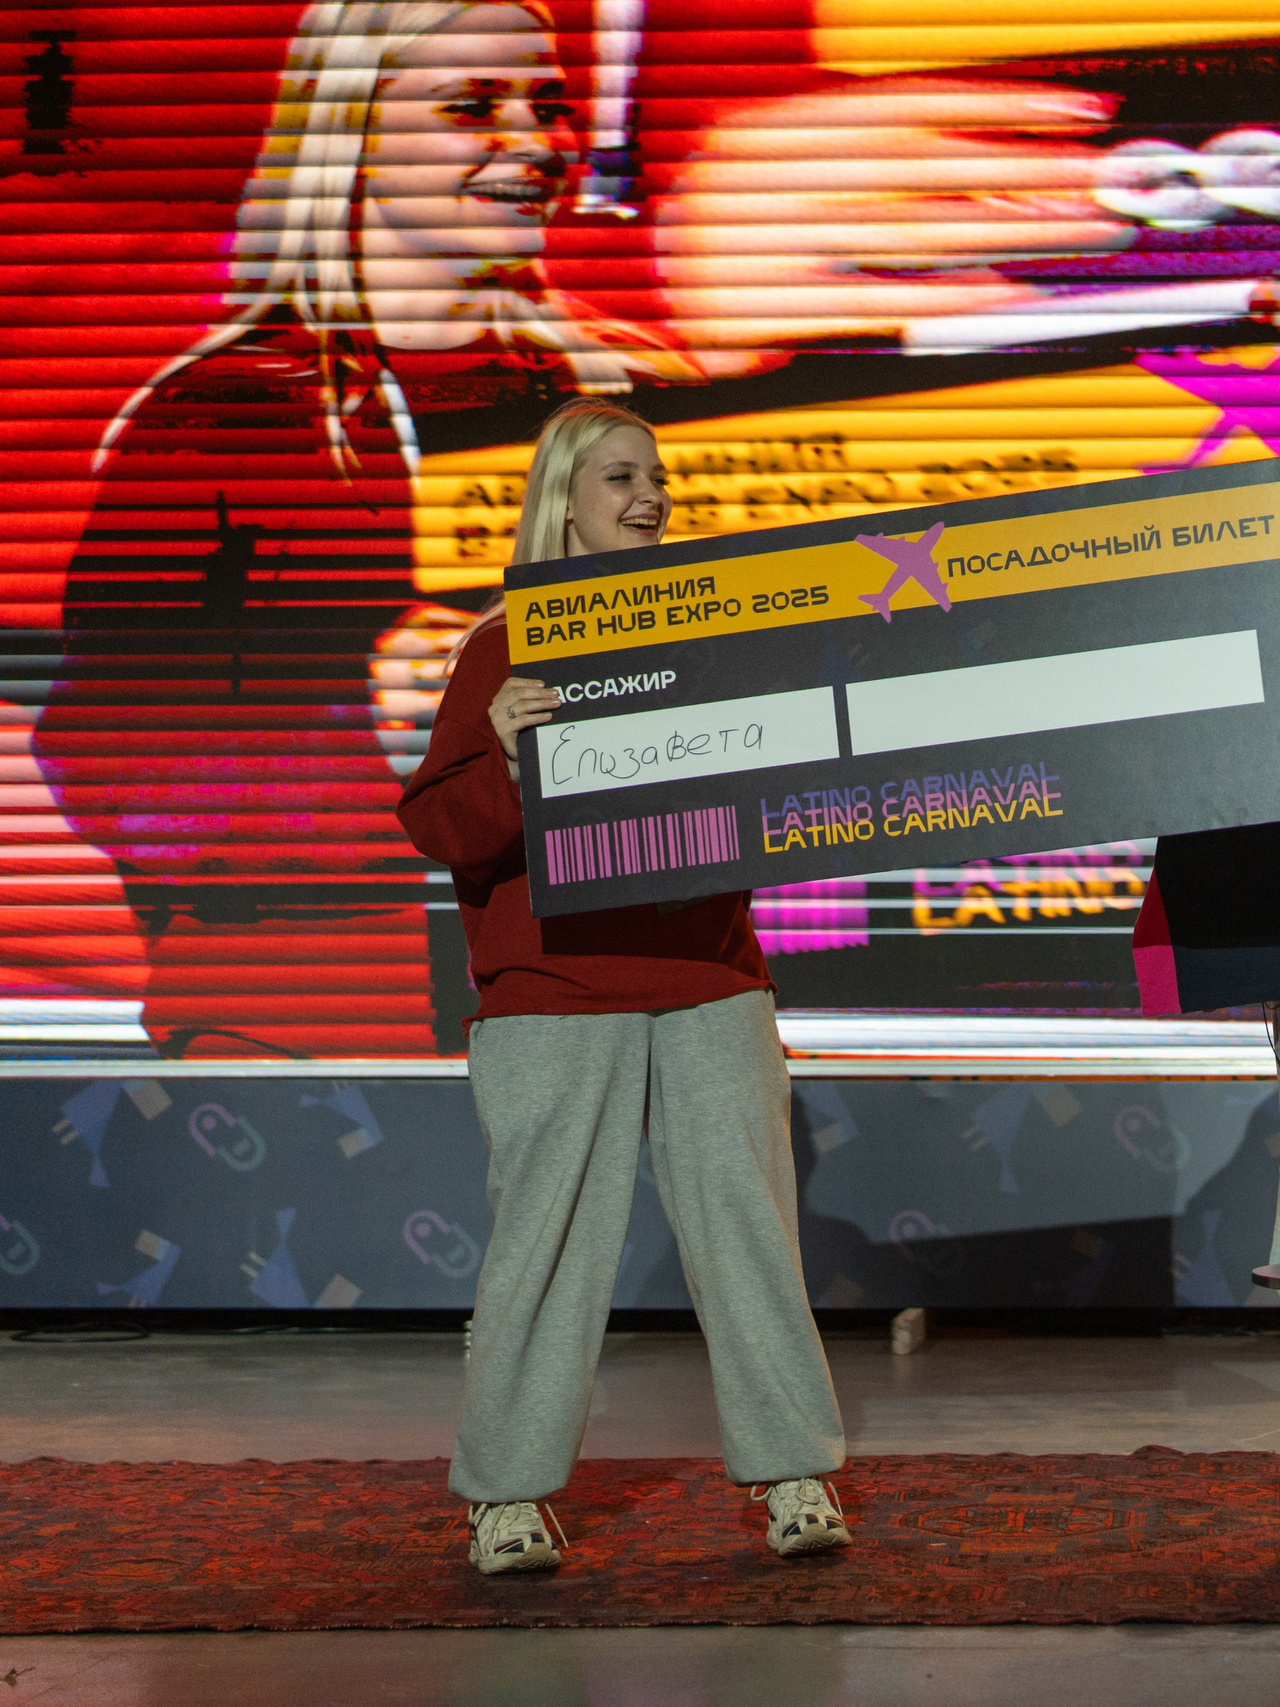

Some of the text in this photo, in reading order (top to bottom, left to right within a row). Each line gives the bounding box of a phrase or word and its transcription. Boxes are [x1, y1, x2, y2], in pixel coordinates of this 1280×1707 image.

[947, 514, 1275, 578] ПОСАДОЧНЫЙ БИЛЕТ
[524, 576, 716, 622] АВИАЛИНИЯ
[526, 586, 830, 646] BAR HUB EXPO 2025
[553, 670, 677, 704] АССАЖИР
[552, 725, 763, 784] Елизавета
[760, 762, 1060, 818] LATINO CARNAVAL
[762, 779, 1062, 835] LATINO CARNAVAL
[764, 796, 1064, 853] LATINO CARNAVAL
